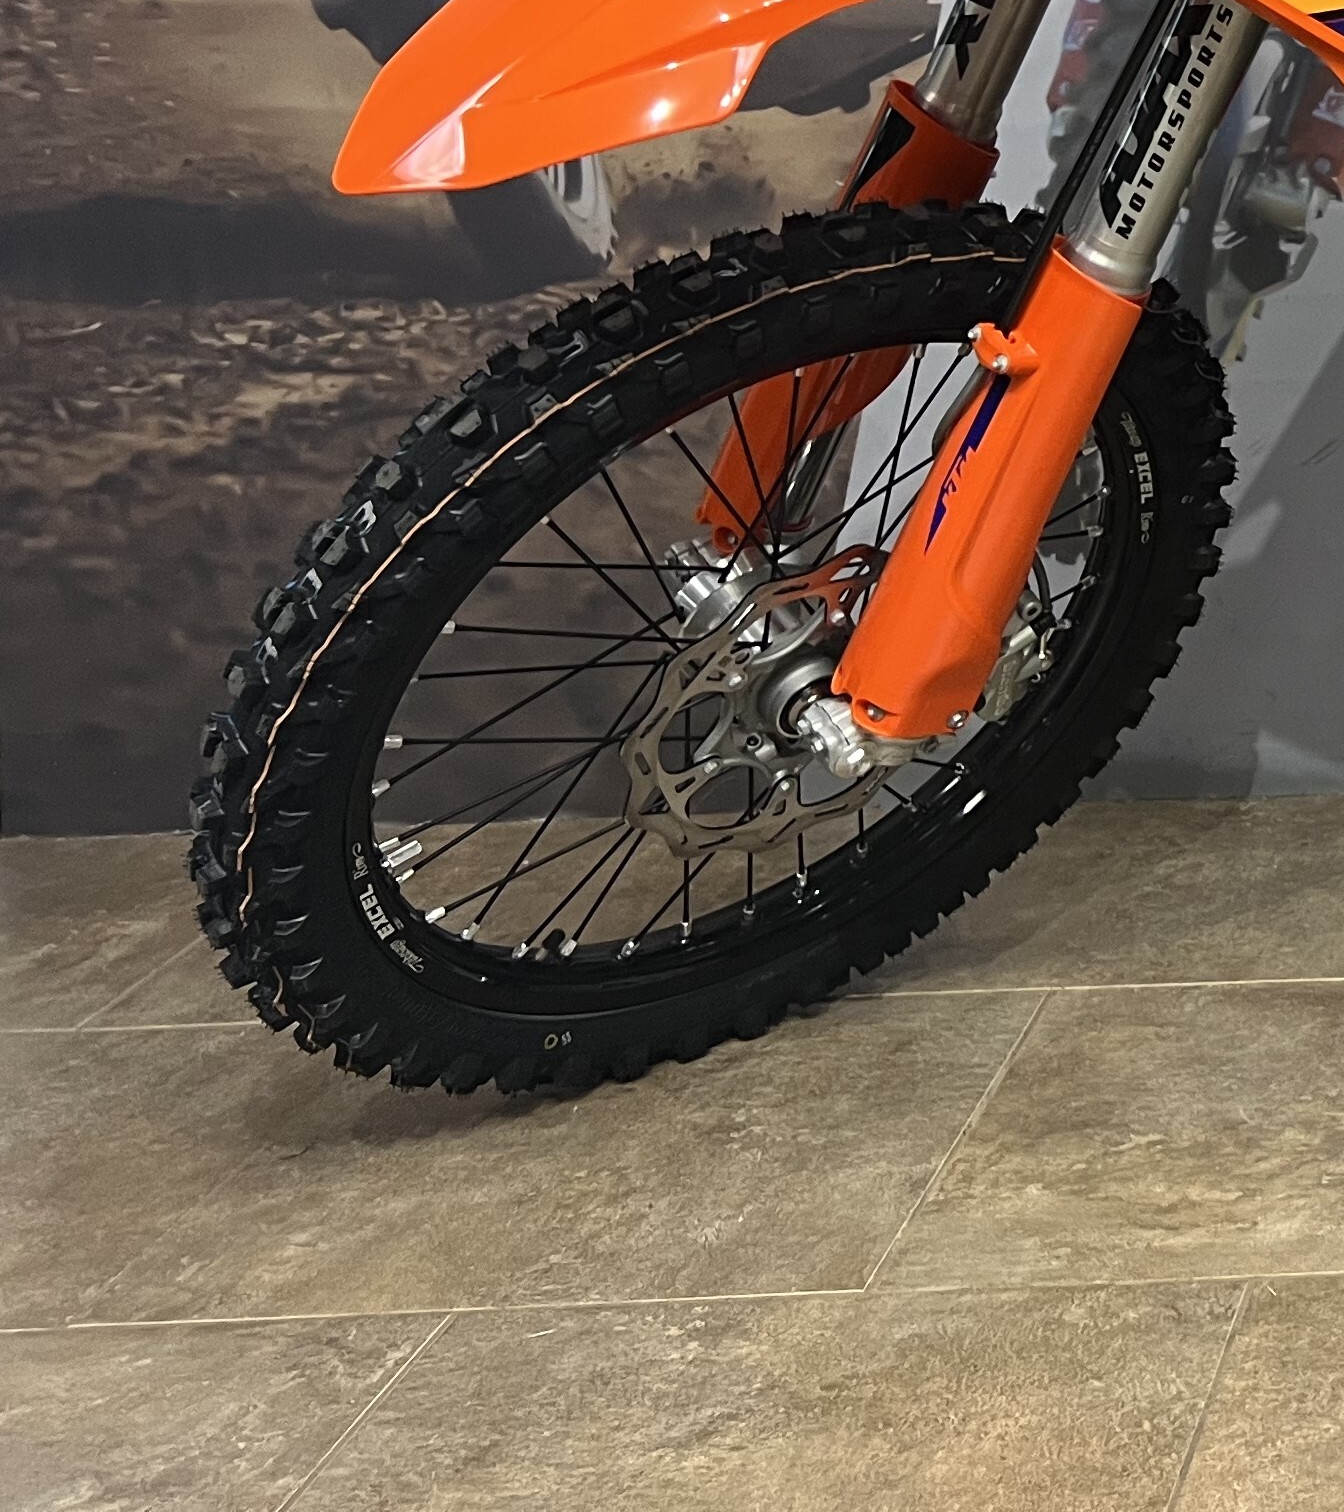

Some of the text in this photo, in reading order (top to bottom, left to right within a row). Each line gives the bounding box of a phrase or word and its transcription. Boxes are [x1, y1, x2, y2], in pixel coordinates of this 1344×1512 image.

[1115, 4, 1234, 240] MOTORSPORTS
[1134, 451, 1154, 505] EXCEL
[360, 883, 395, 941] EXCEL
